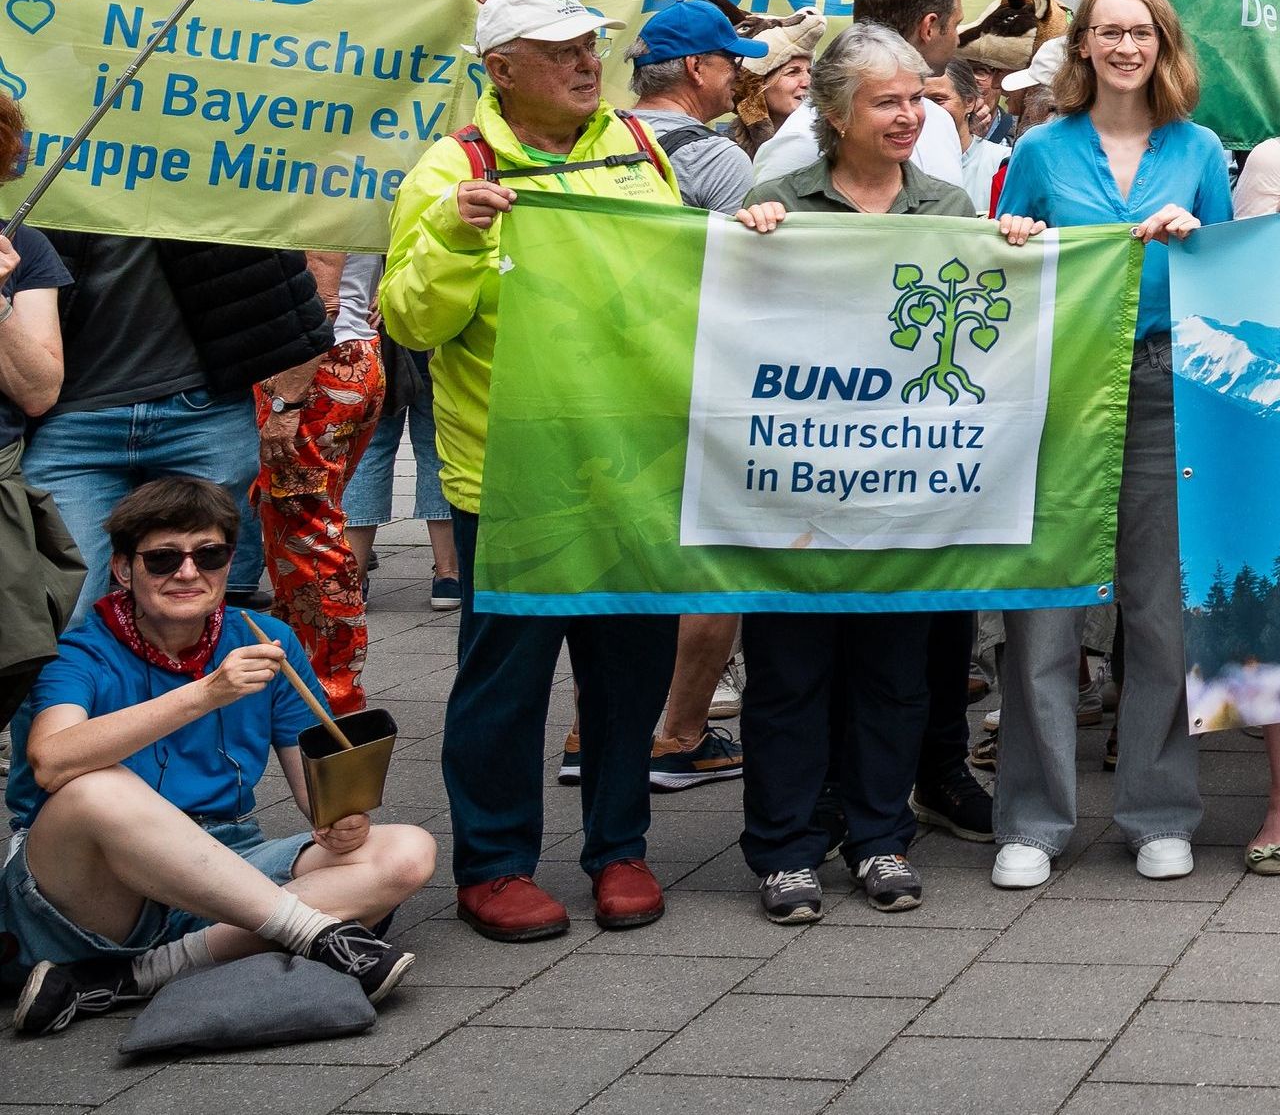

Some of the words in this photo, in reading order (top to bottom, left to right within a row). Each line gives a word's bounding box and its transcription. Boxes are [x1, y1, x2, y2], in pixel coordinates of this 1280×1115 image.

[103, 3, 457, 85] Naturschutz
[94, 63, 142, 111] in
[163, 72, 354, 135] Bayern
[370, 100, 446, 141] e.V.
[208, 140, 405, 202] Münche
[751, 363, 893, 403] BUND
[749, 414, 985, 451] Naturschutz
[746, 459, 779, 492] in
[791, 461, 918, 502] Bayern
[928, 462, 982, 494] e.V.
